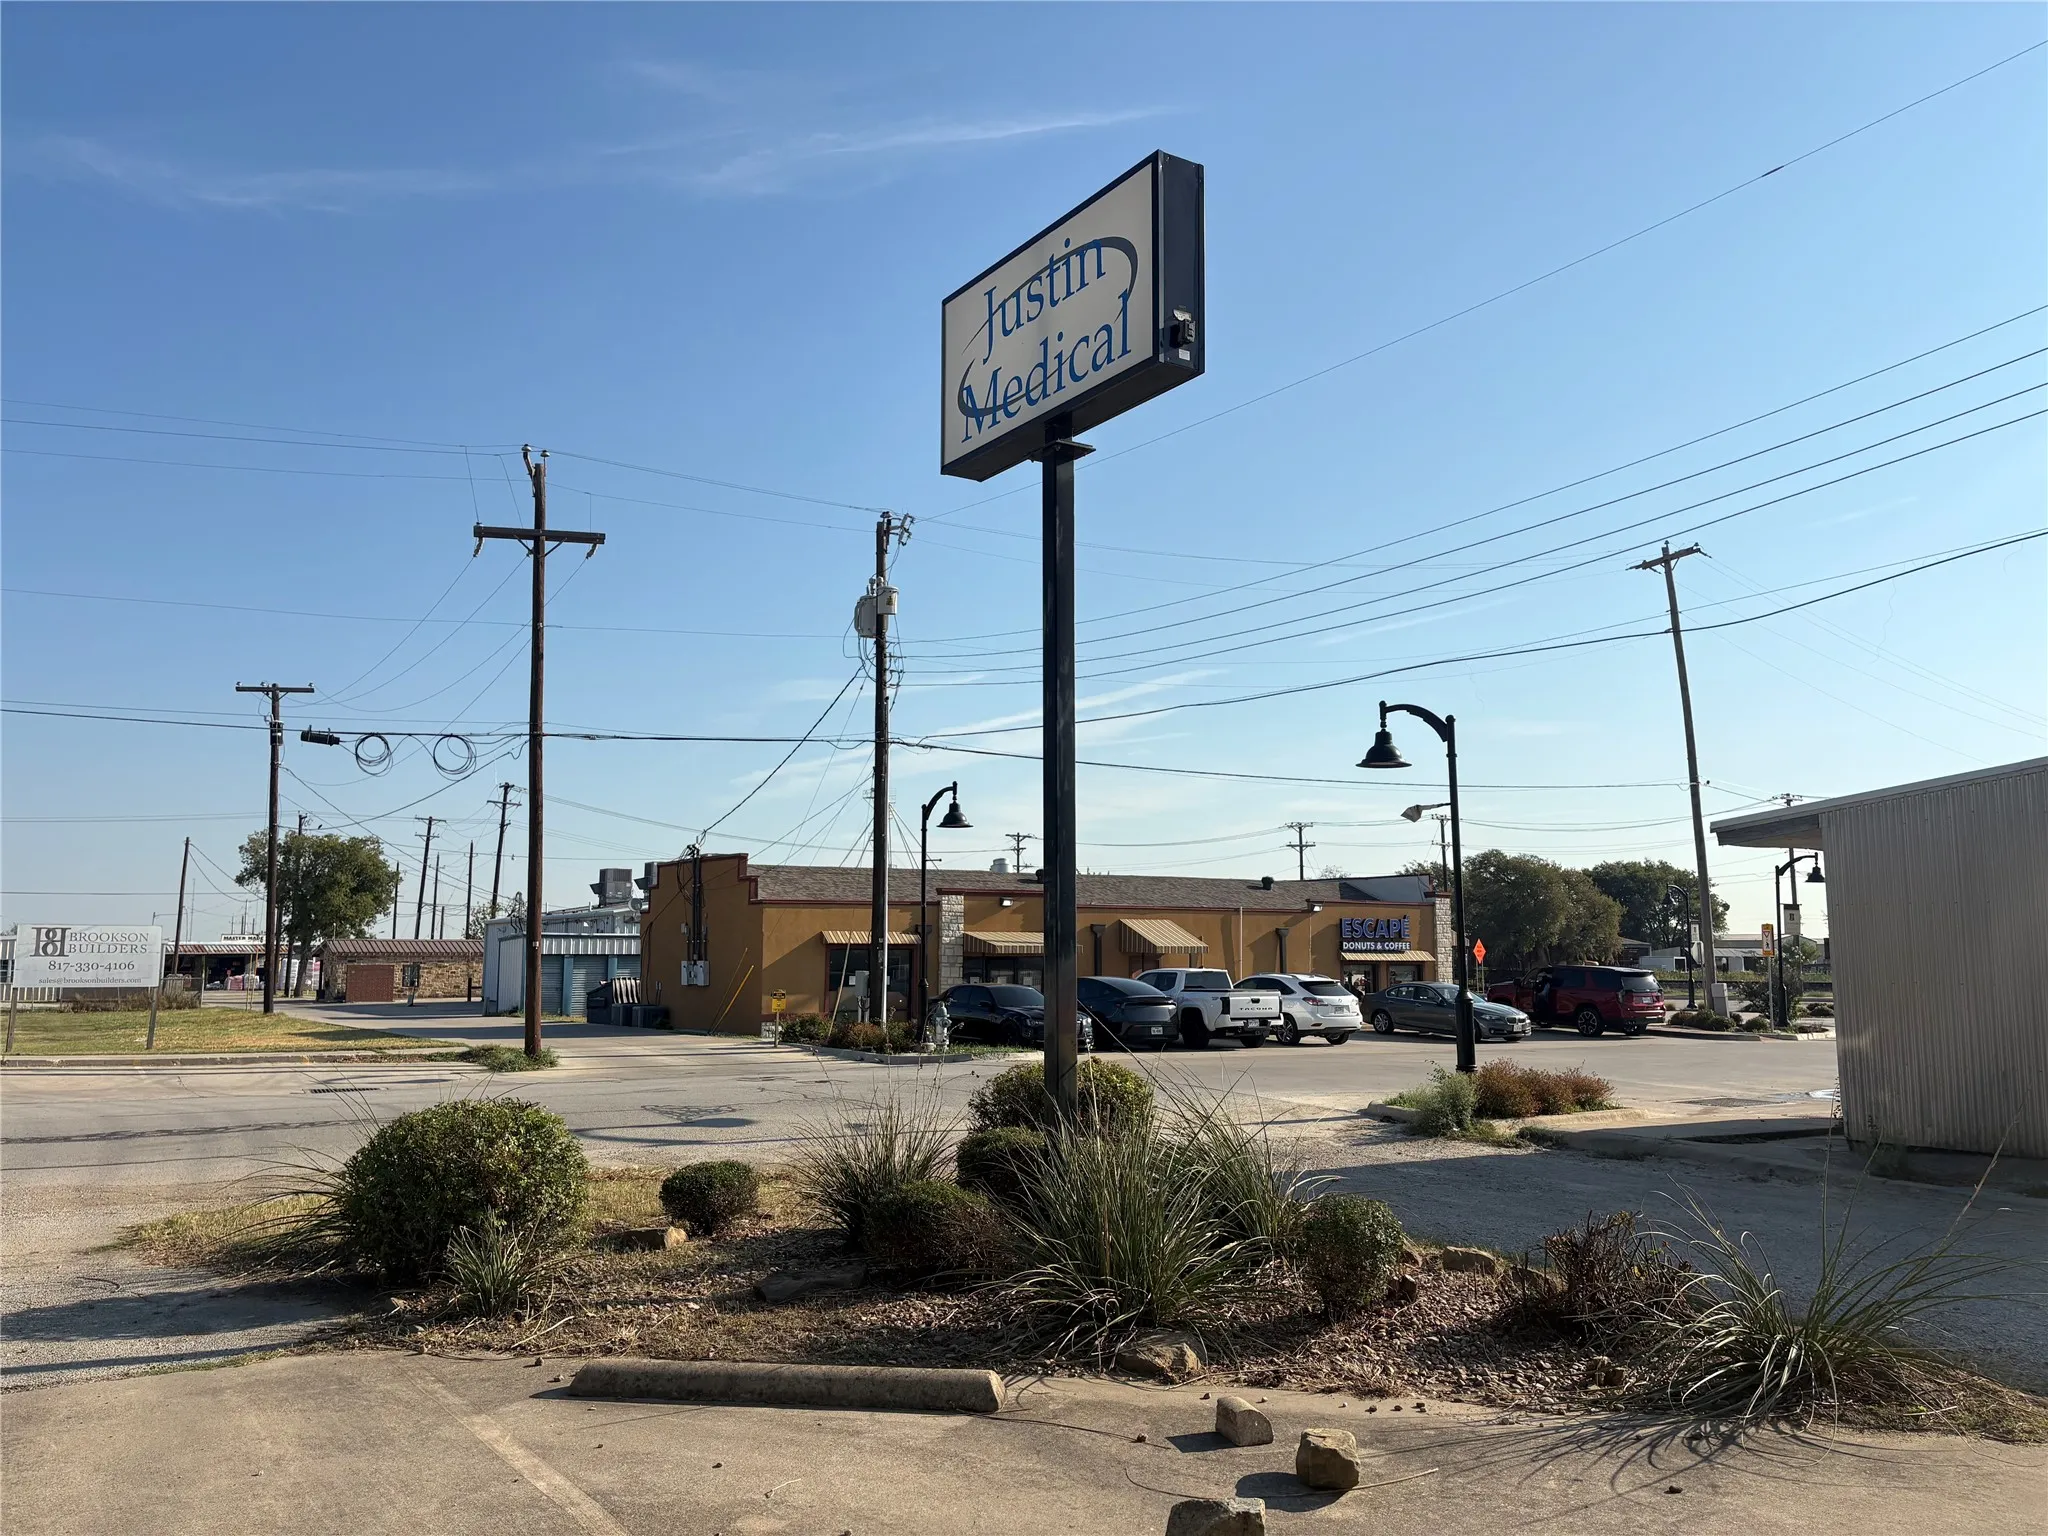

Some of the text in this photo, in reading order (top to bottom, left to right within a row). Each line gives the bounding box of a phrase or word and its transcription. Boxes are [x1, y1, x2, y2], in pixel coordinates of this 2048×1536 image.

[982, 237, 1106, 365] Justin
[961, 288, 1132, 443] Medical
[1340, 915, 1410, 939] ESCAPÉ
[69, 932, 149, 943] BROOKSON
[68, 944, 147, 954] BUILDERS
[1342, 941, 1411, 950] DONUTS & COFFEE
[48, 960, 135, 973] 817-330-4106
